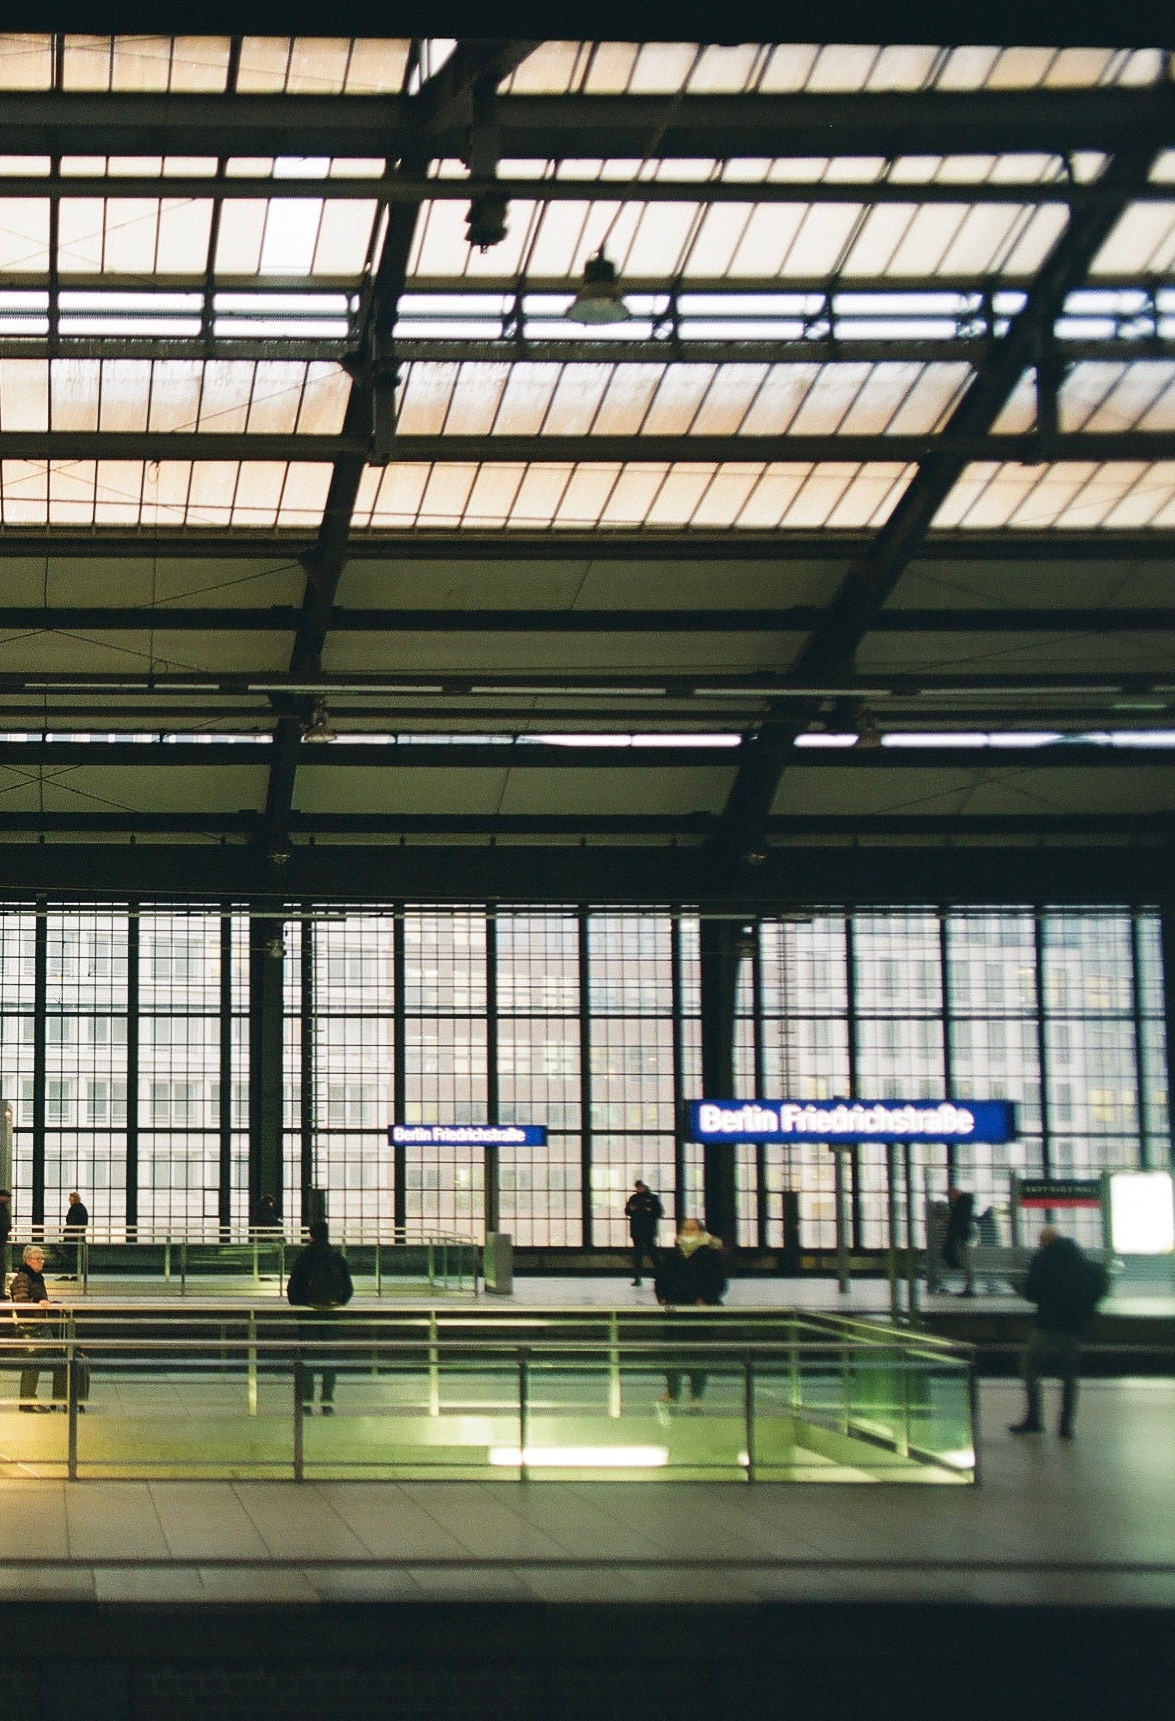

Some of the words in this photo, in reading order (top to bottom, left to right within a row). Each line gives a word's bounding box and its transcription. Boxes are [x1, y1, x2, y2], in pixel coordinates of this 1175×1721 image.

[699, 1104, 777, 1132] Berlin
[779, 1103, 974, 1134] Friedrichstraße
[393, 1127, 431, 1141] Berlin
[432, 1127, 525, 1142] Friedrichstraße
